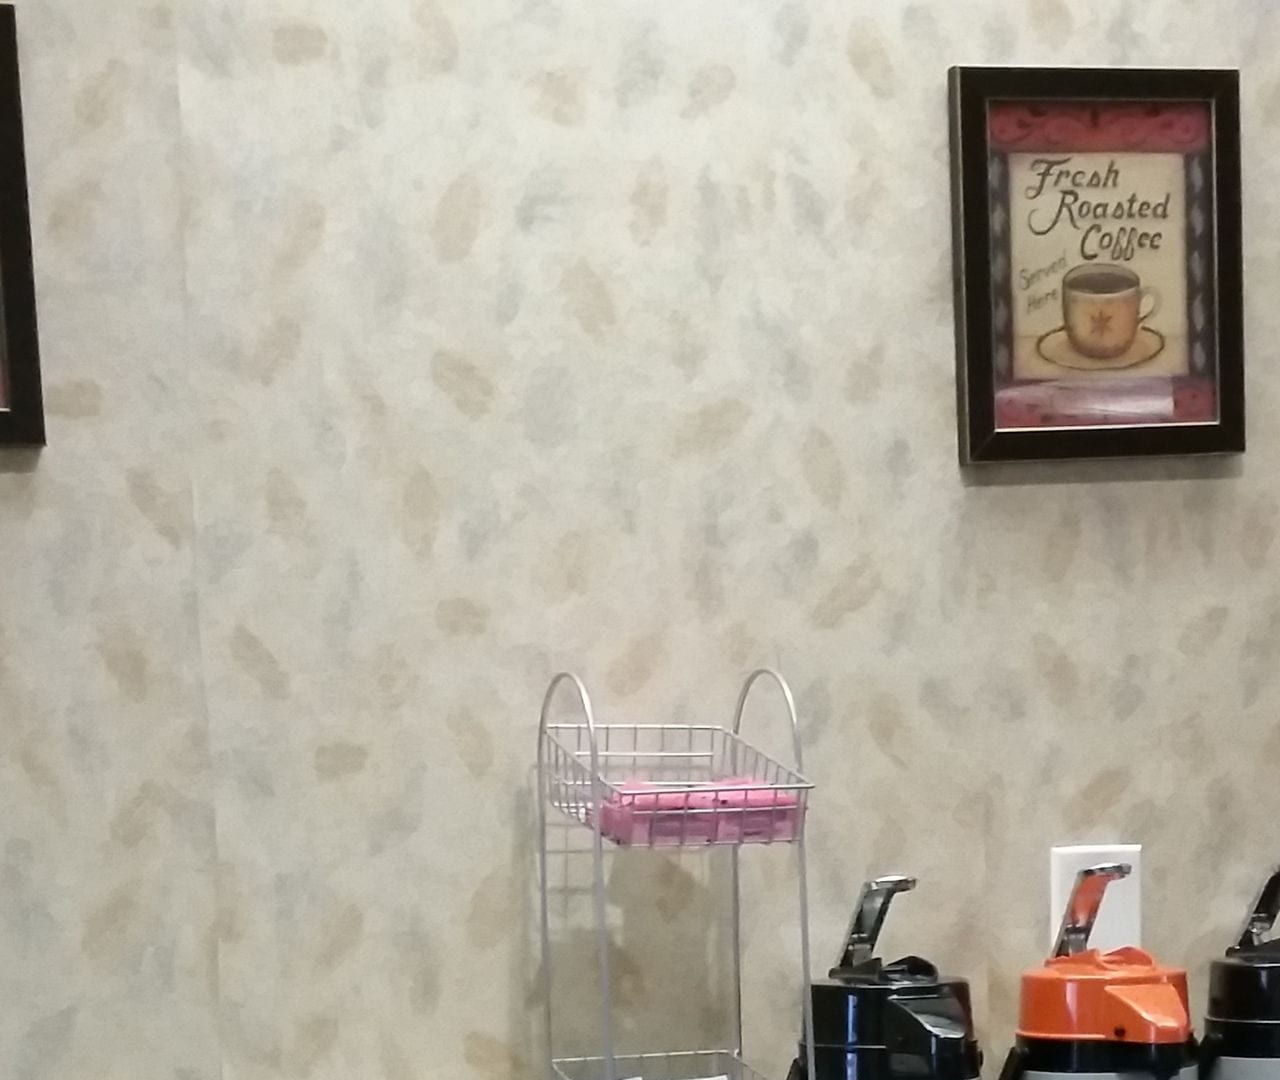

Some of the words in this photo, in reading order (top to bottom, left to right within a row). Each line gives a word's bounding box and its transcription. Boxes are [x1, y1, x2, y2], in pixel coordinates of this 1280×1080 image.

[1025, 157, 1119, 200] Fresh
[1028, 189, 1170, 236] Roasted
[1080, 223, 1162, 261] Coffee
